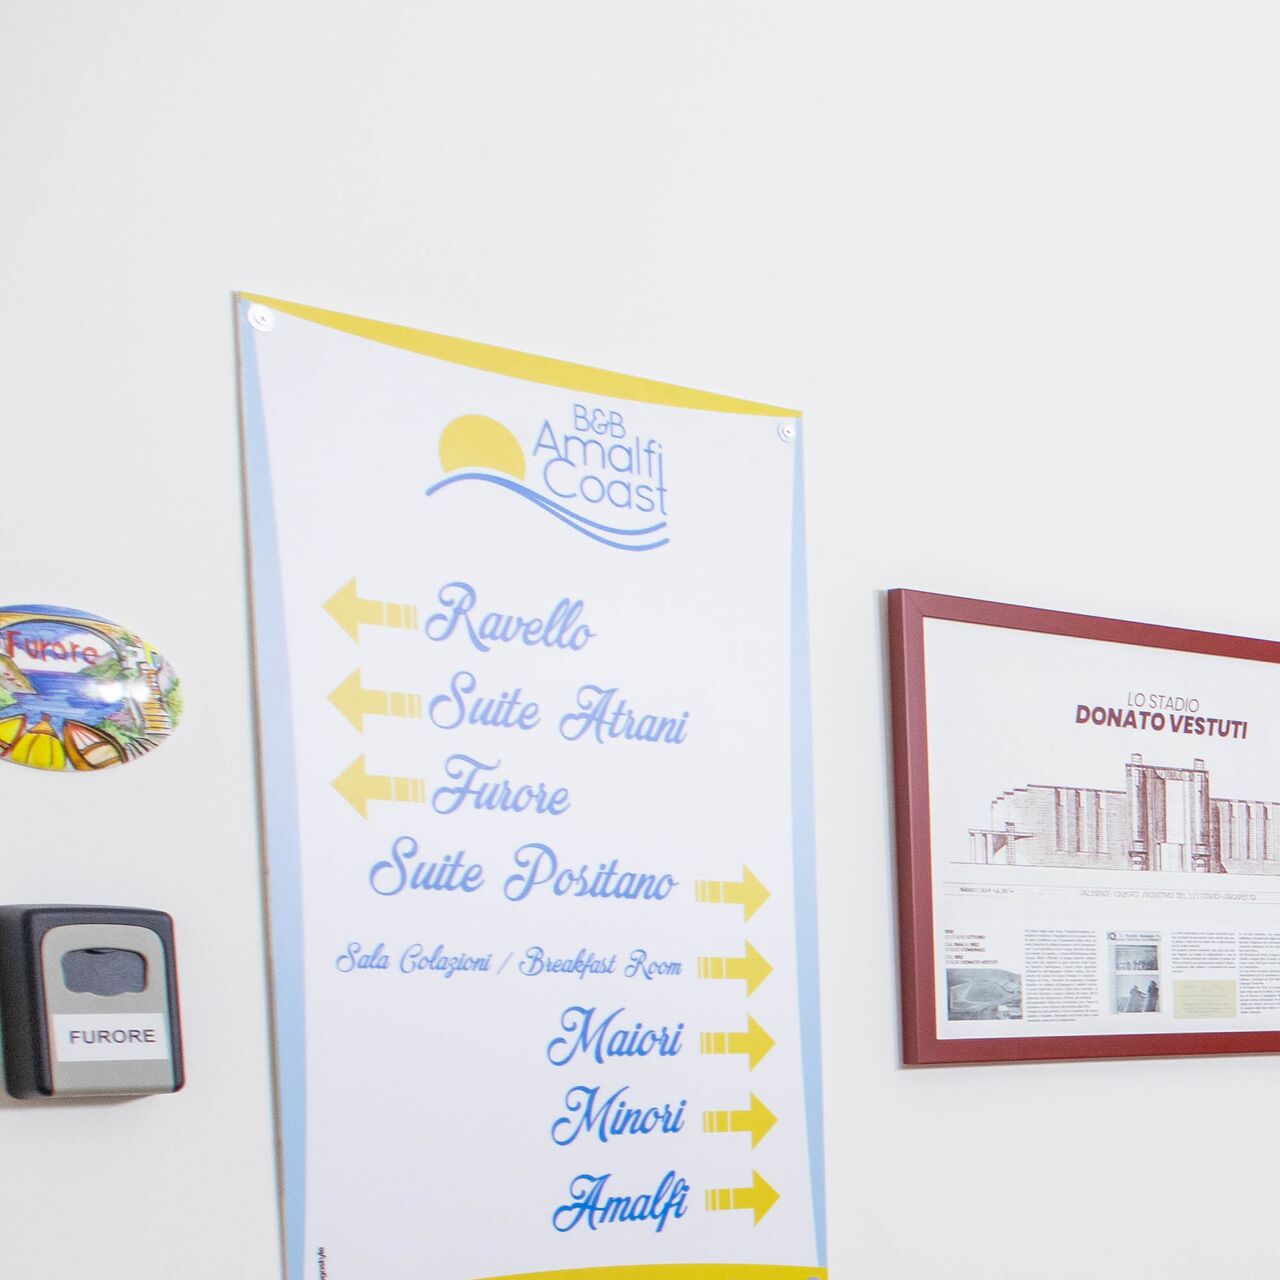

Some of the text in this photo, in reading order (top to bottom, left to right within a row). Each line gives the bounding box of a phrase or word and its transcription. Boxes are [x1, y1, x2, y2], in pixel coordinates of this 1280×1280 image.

[532, 419, 663, 478] Amalfi
[573, 404, 626, 439] B&B
[543, 457, 668, 516] Coast
[425, 581, 597, 653] Ravello
[5, 630, 100, 667] Furore
[429, 671, 690, 744] Suite Atrani
[1076, 705, 1248, 739] DONATO VESTUTI
[1127, 691, 1200, 713] LO STADIO
[432, 753, 571, 815] Furore
[369, 836, 679, 902] Suite Positano
[336, 942, 391, 973] Sala
[400, 943, 493, 978] Colazioni
[518, 946, 617, 980] Breakfast
[624, 949, 682, 980] Room
[69, 1029, 156, 1044] FURORE
[546, 1006, 684, 1066] Maiori
[551, 1085, 687, 1146] Minori
[552, 1170, 690, 1233] Amalfi
